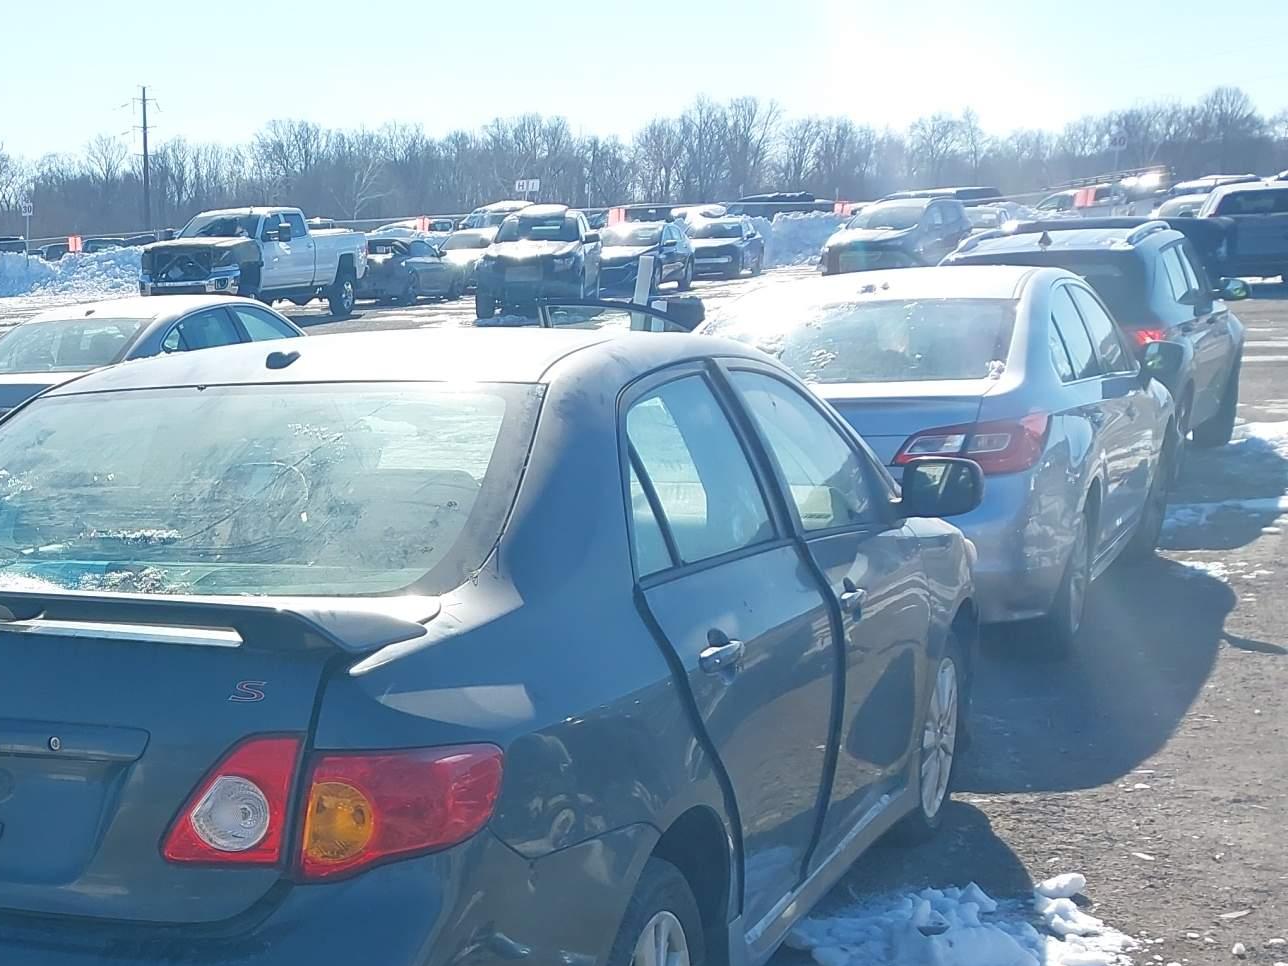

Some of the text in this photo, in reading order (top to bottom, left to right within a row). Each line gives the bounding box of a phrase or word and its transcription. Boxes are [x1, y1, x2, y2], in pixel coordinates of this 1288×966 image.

[517, 180, 525, 190] H
[22, 205, 32, 214] 30
[228, 680, 268, 702] S
